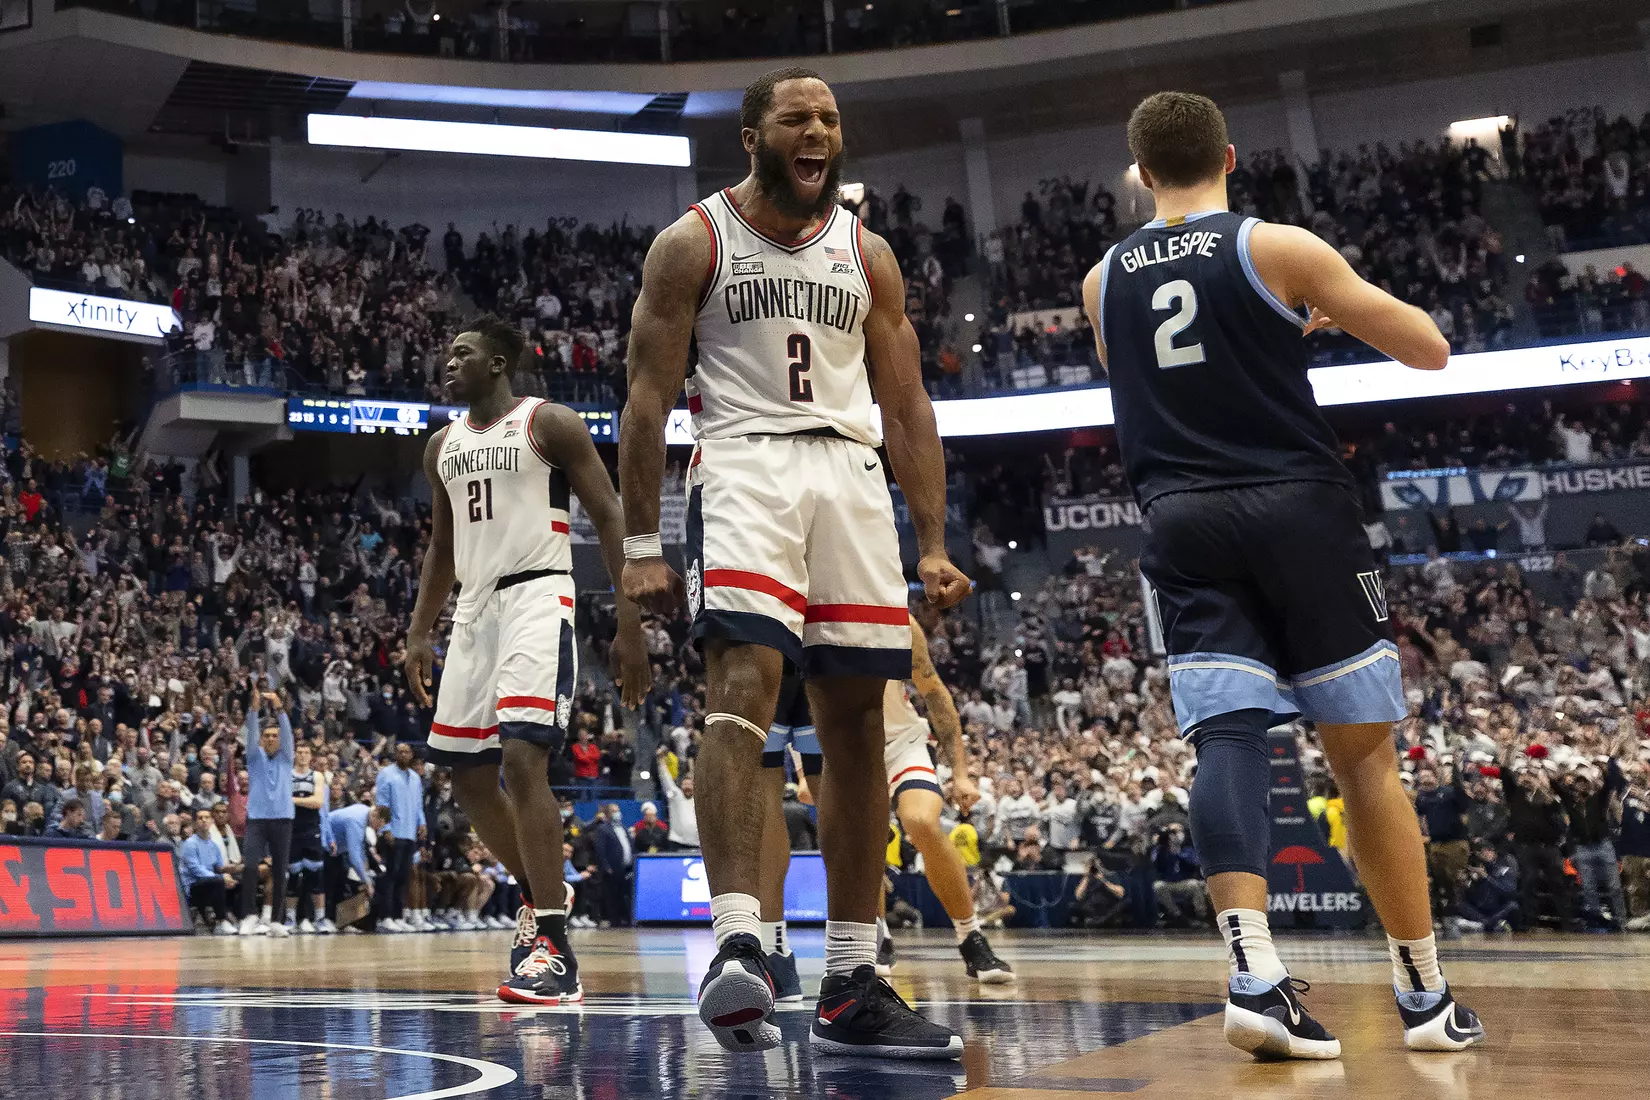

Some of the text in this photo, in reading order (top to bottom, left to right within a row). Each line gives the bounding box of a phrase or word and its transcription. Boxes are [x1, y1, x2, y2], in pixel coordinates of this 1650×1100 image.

[48, 159, 76, 179] 220
[831, 266, 855, 274] EAST
[1120, 231, 1222, 273] GILLESPIE
[67, 298, 138, 331] xfinity
[724, 277, 861, 334] CONNECTICUT
[1151, 279, 1206, 369] 2
[786, 333, 814, 403] 2
[441, 446, 521, 486] CONNECTICUT
[467, 478, 494, 523] 21
[0, 845, 183, 930] & SON
